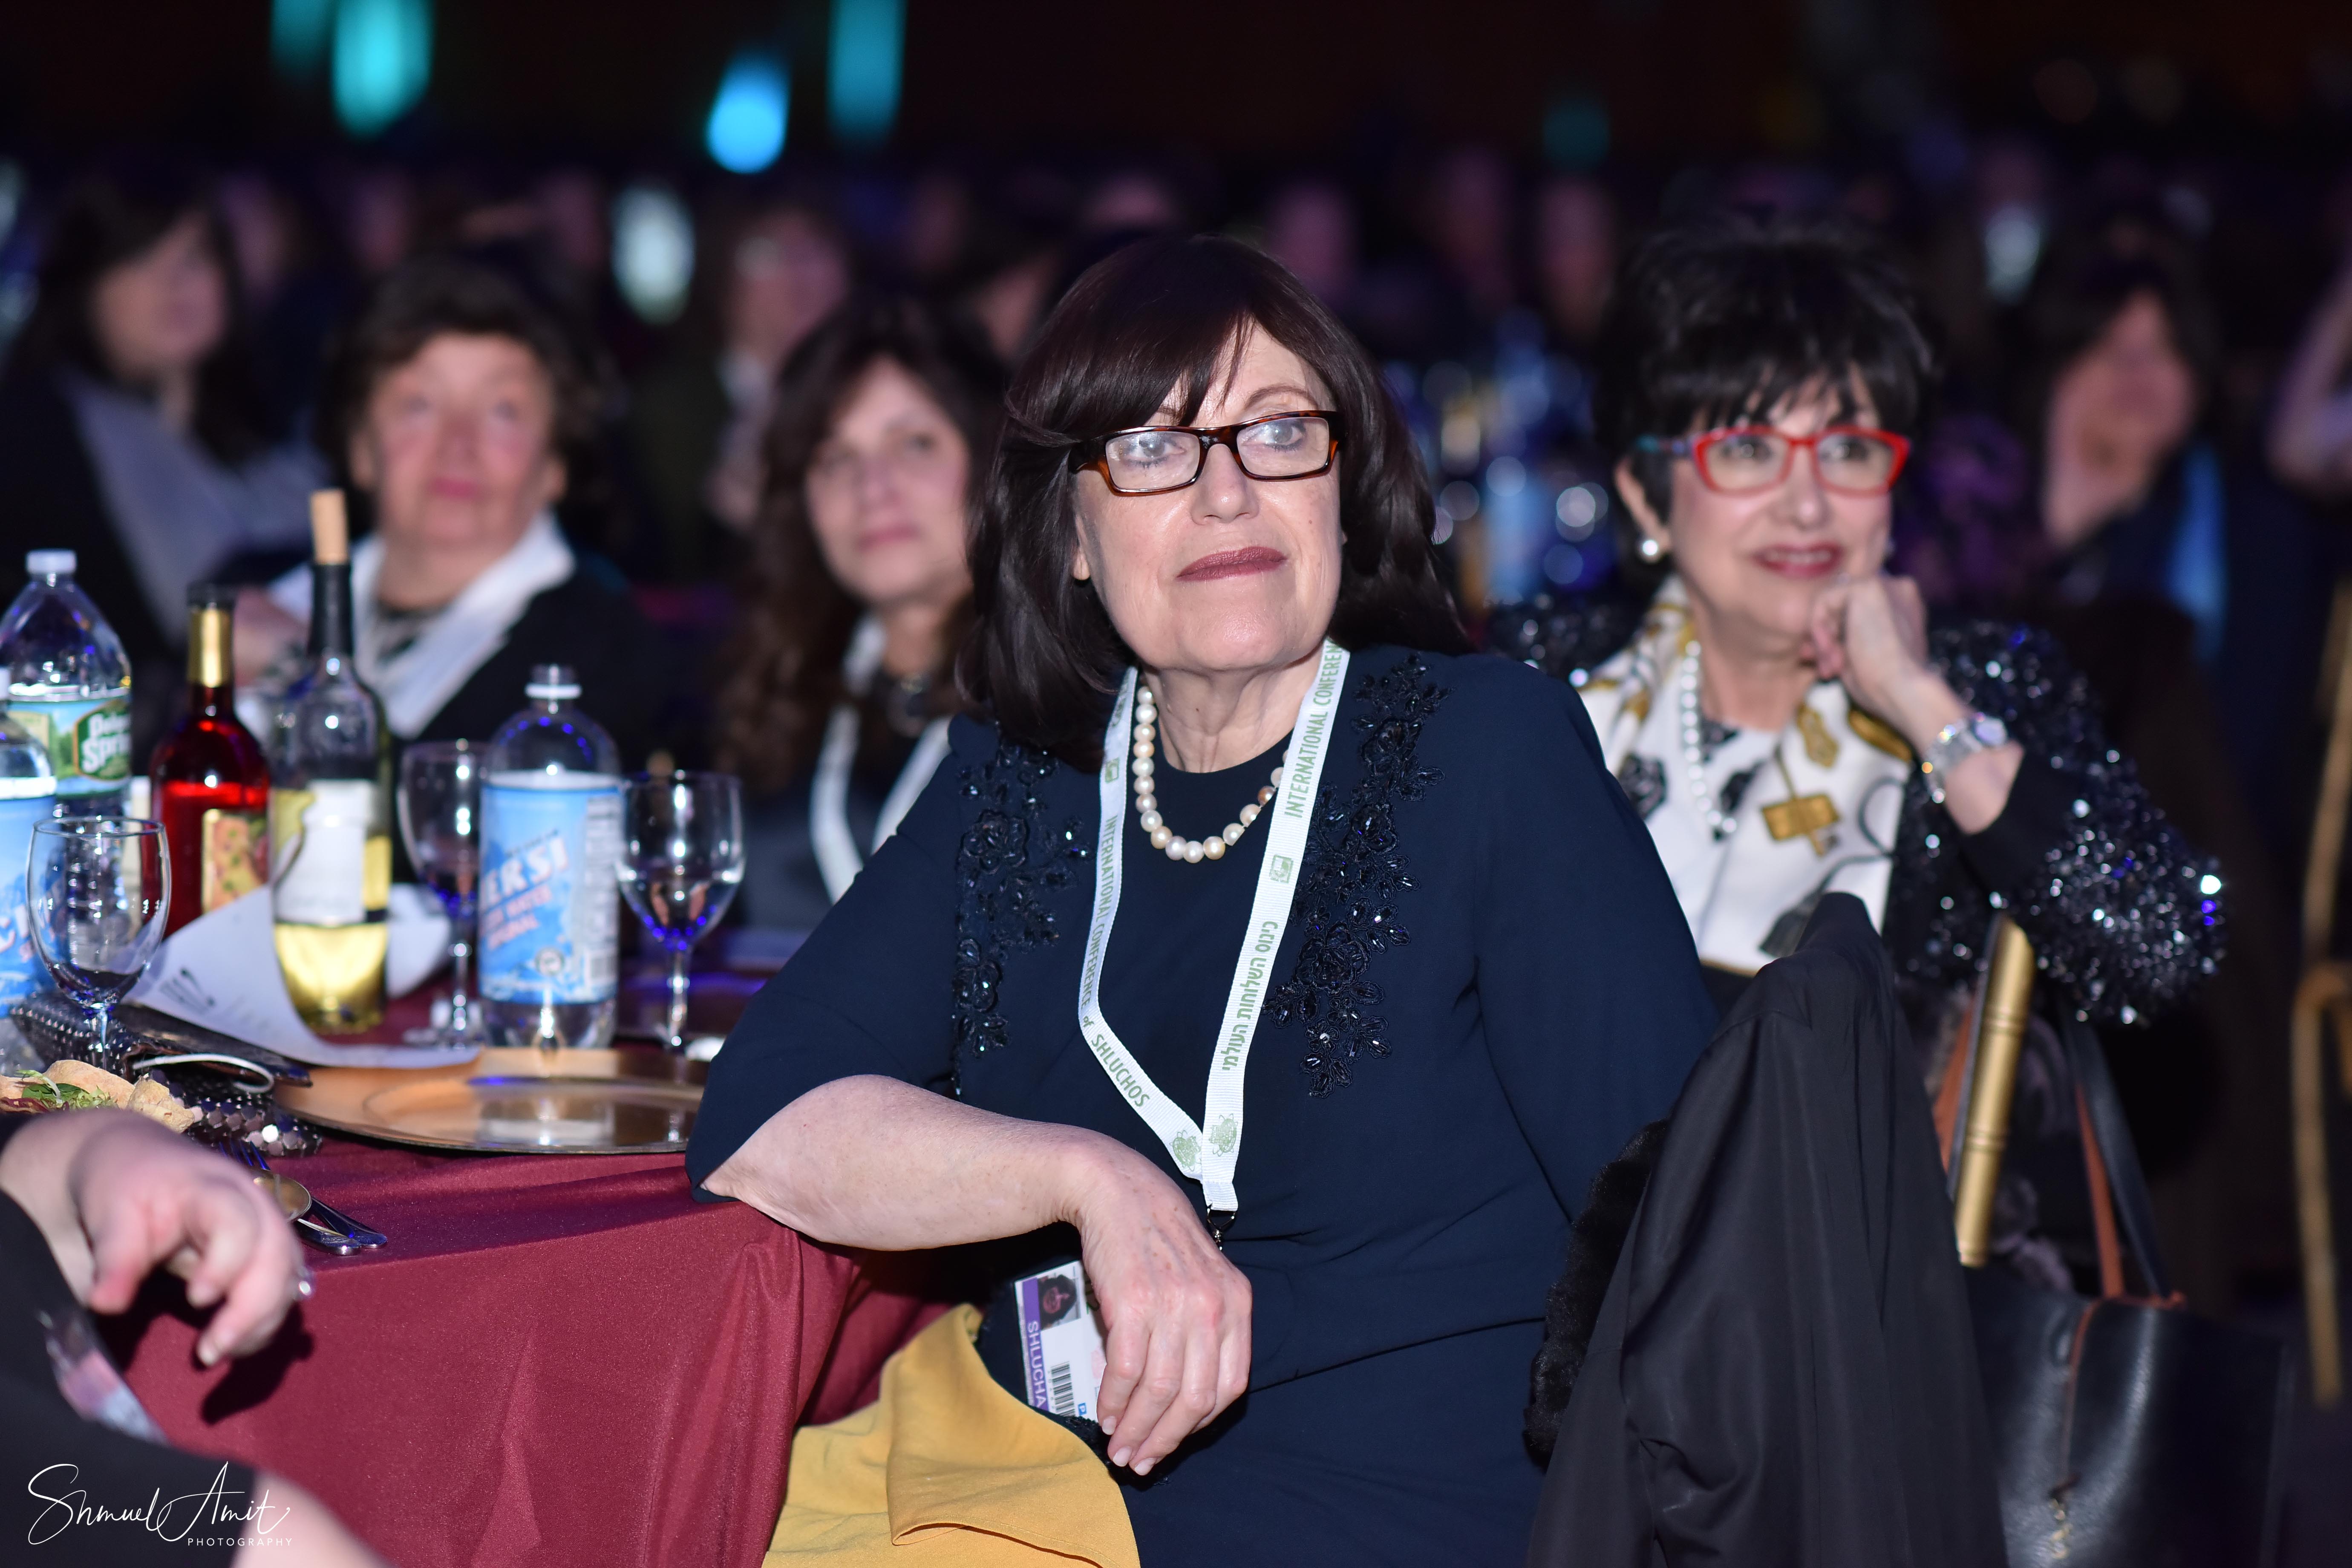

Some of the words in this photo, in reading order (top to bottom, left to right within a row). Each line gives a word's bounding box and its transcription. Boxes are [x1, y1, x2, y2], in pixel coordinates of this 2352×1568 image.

[1284, 711, 1329, 818] INTERNATIONAL
[1096, 815, 1118, 922] INTERNATIONAL
[1081, 923, 1105, 1010] CONFERENCE
[1255, 921, 1278, 952] כינוס
[1084, 1016, 1094, 1027] of
[1237, 957, 1267, 1020] השלוחות
[1092, 1034, 1150, 1107] SHLUCHOS
[1220, 1024, 1249, 1070] העולמי
[1028, 1321, 1046, 1407] SHLUCHA
